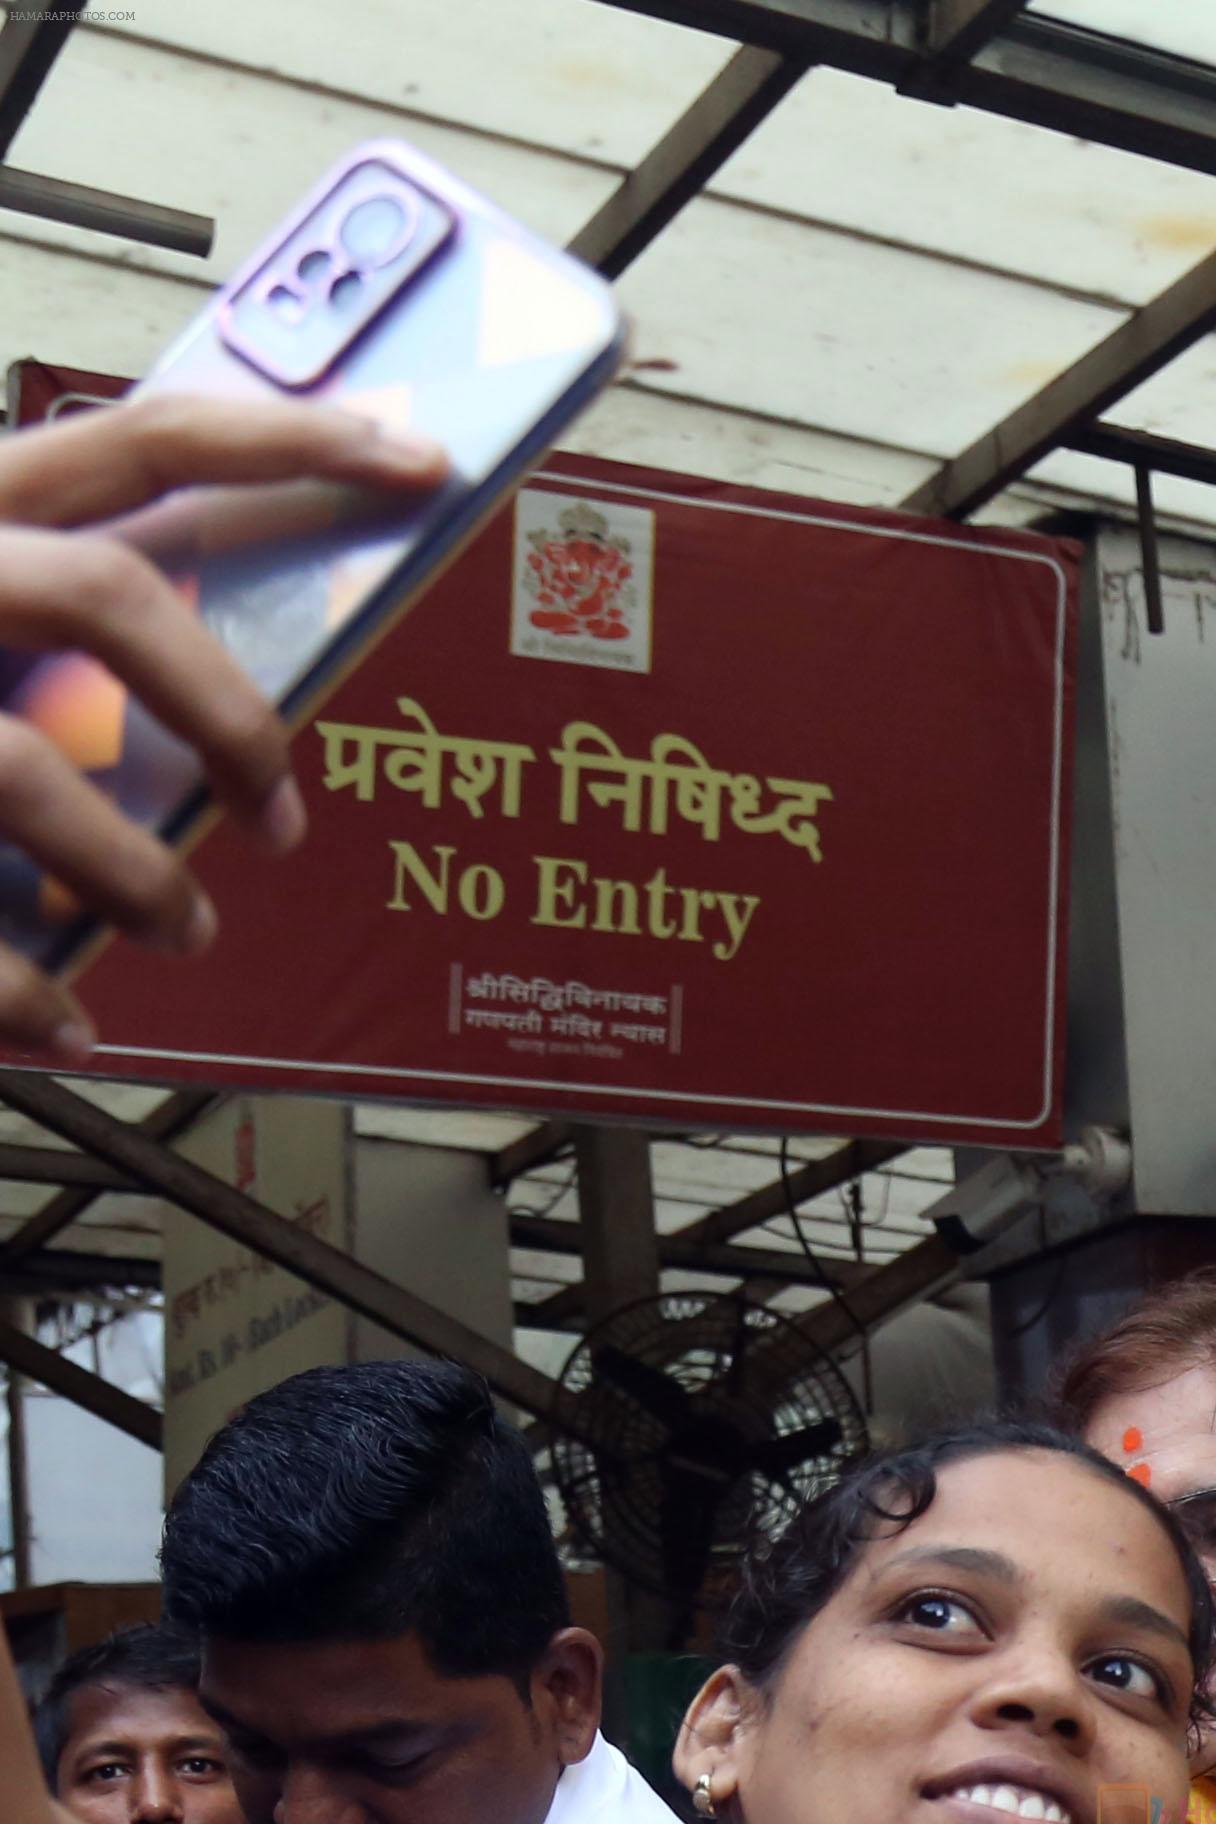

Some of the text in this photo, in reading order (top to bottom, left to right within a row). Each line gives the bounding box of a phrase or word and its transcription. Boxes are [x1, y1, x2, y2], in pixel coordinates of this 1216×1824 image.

[314, 697, 536, 818] प्रवेश
[386, 840, 761, 961] No Entry
